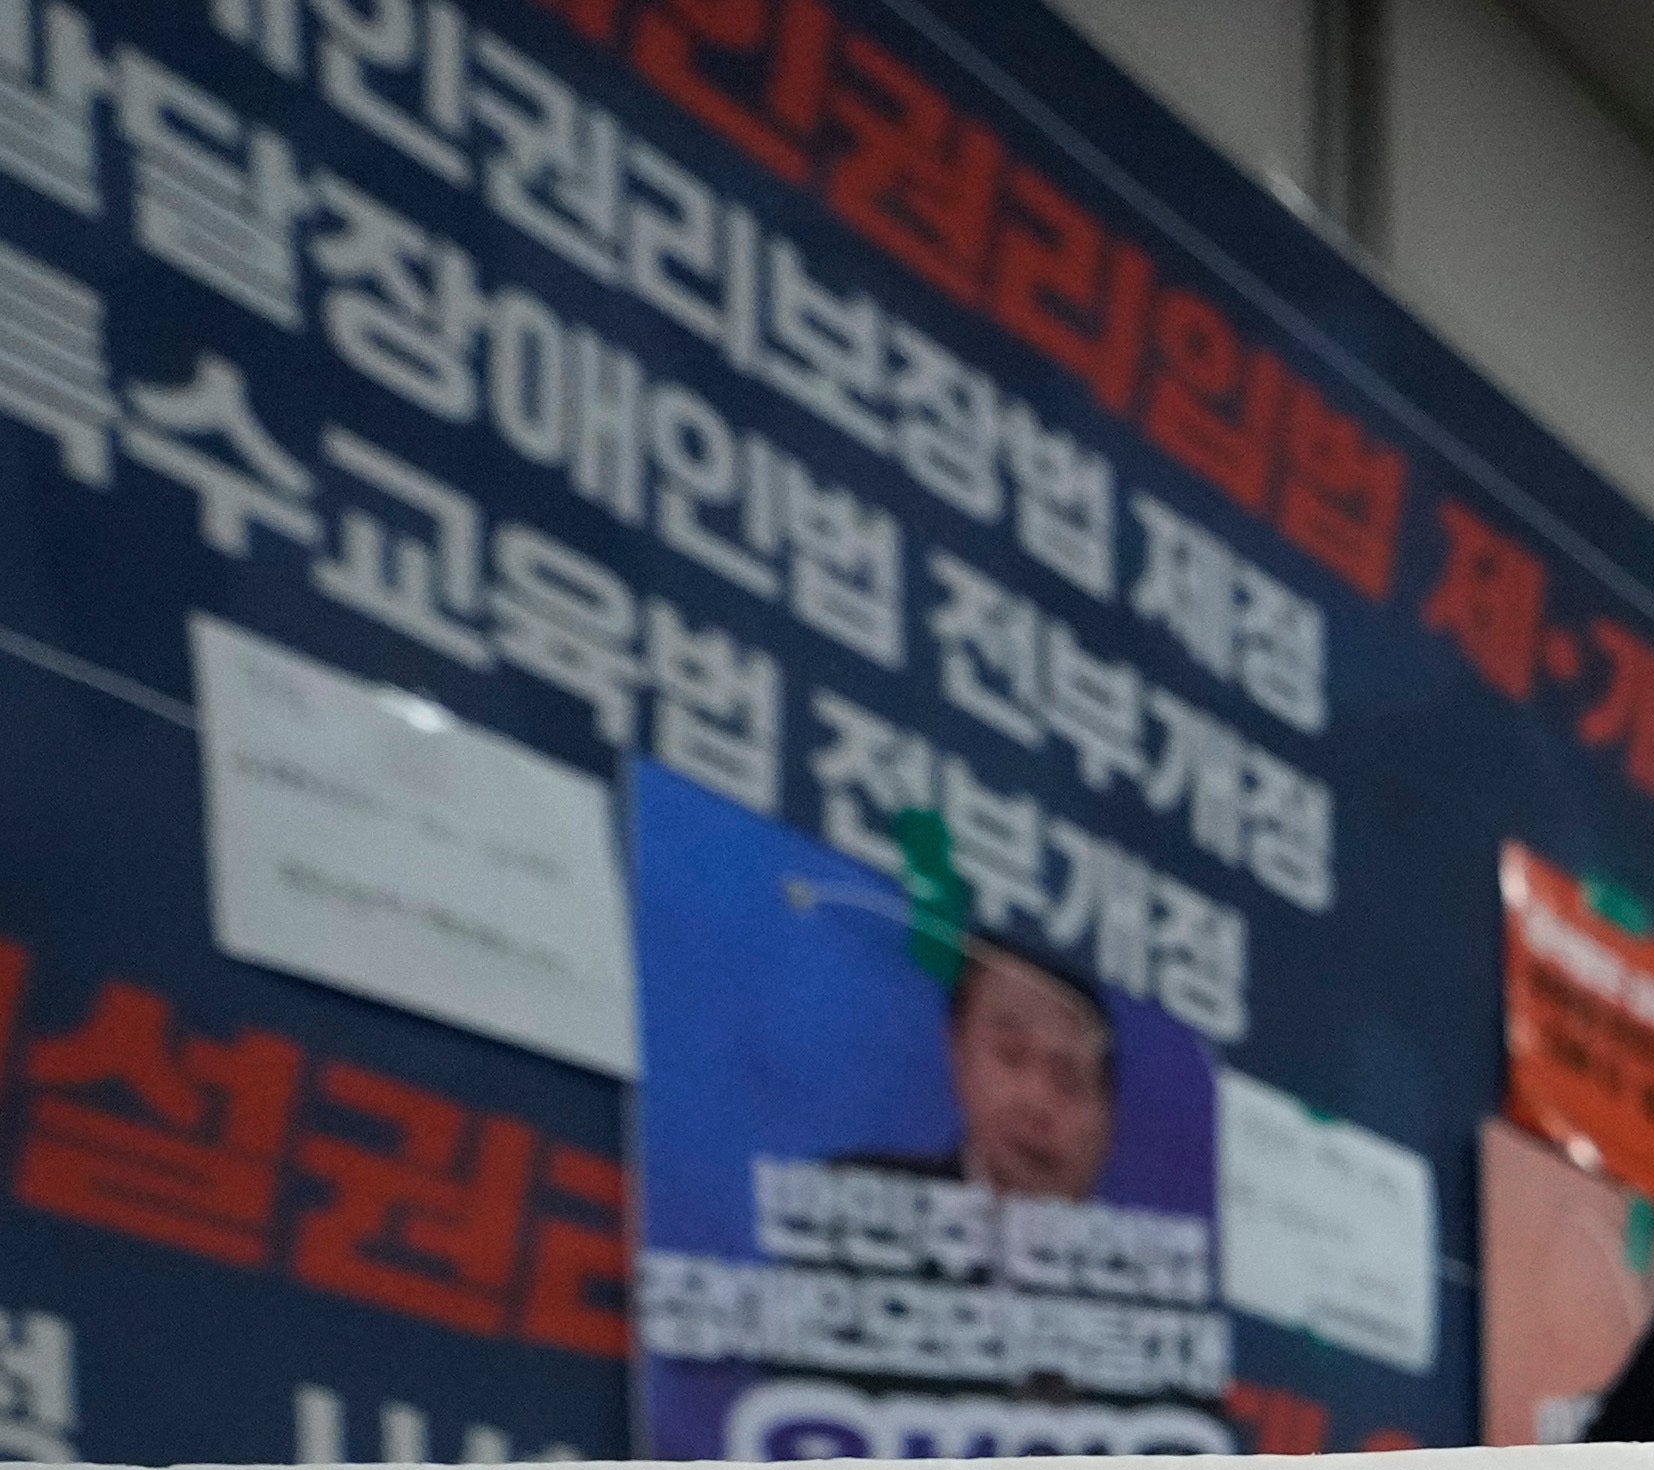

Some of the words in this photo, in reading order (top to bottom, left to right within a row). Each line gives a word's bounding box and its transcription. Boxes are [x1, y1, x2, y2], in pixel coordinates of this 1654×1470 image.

[207, 0, 1116, 602] 인권리보장법
[1132, 492, 1327, 738] 제정
[540, 0, 1410, 603] 인권리입법
[925, 548, 1335, 913] 전부개정
[0, 936, 632, 1360] 설권
